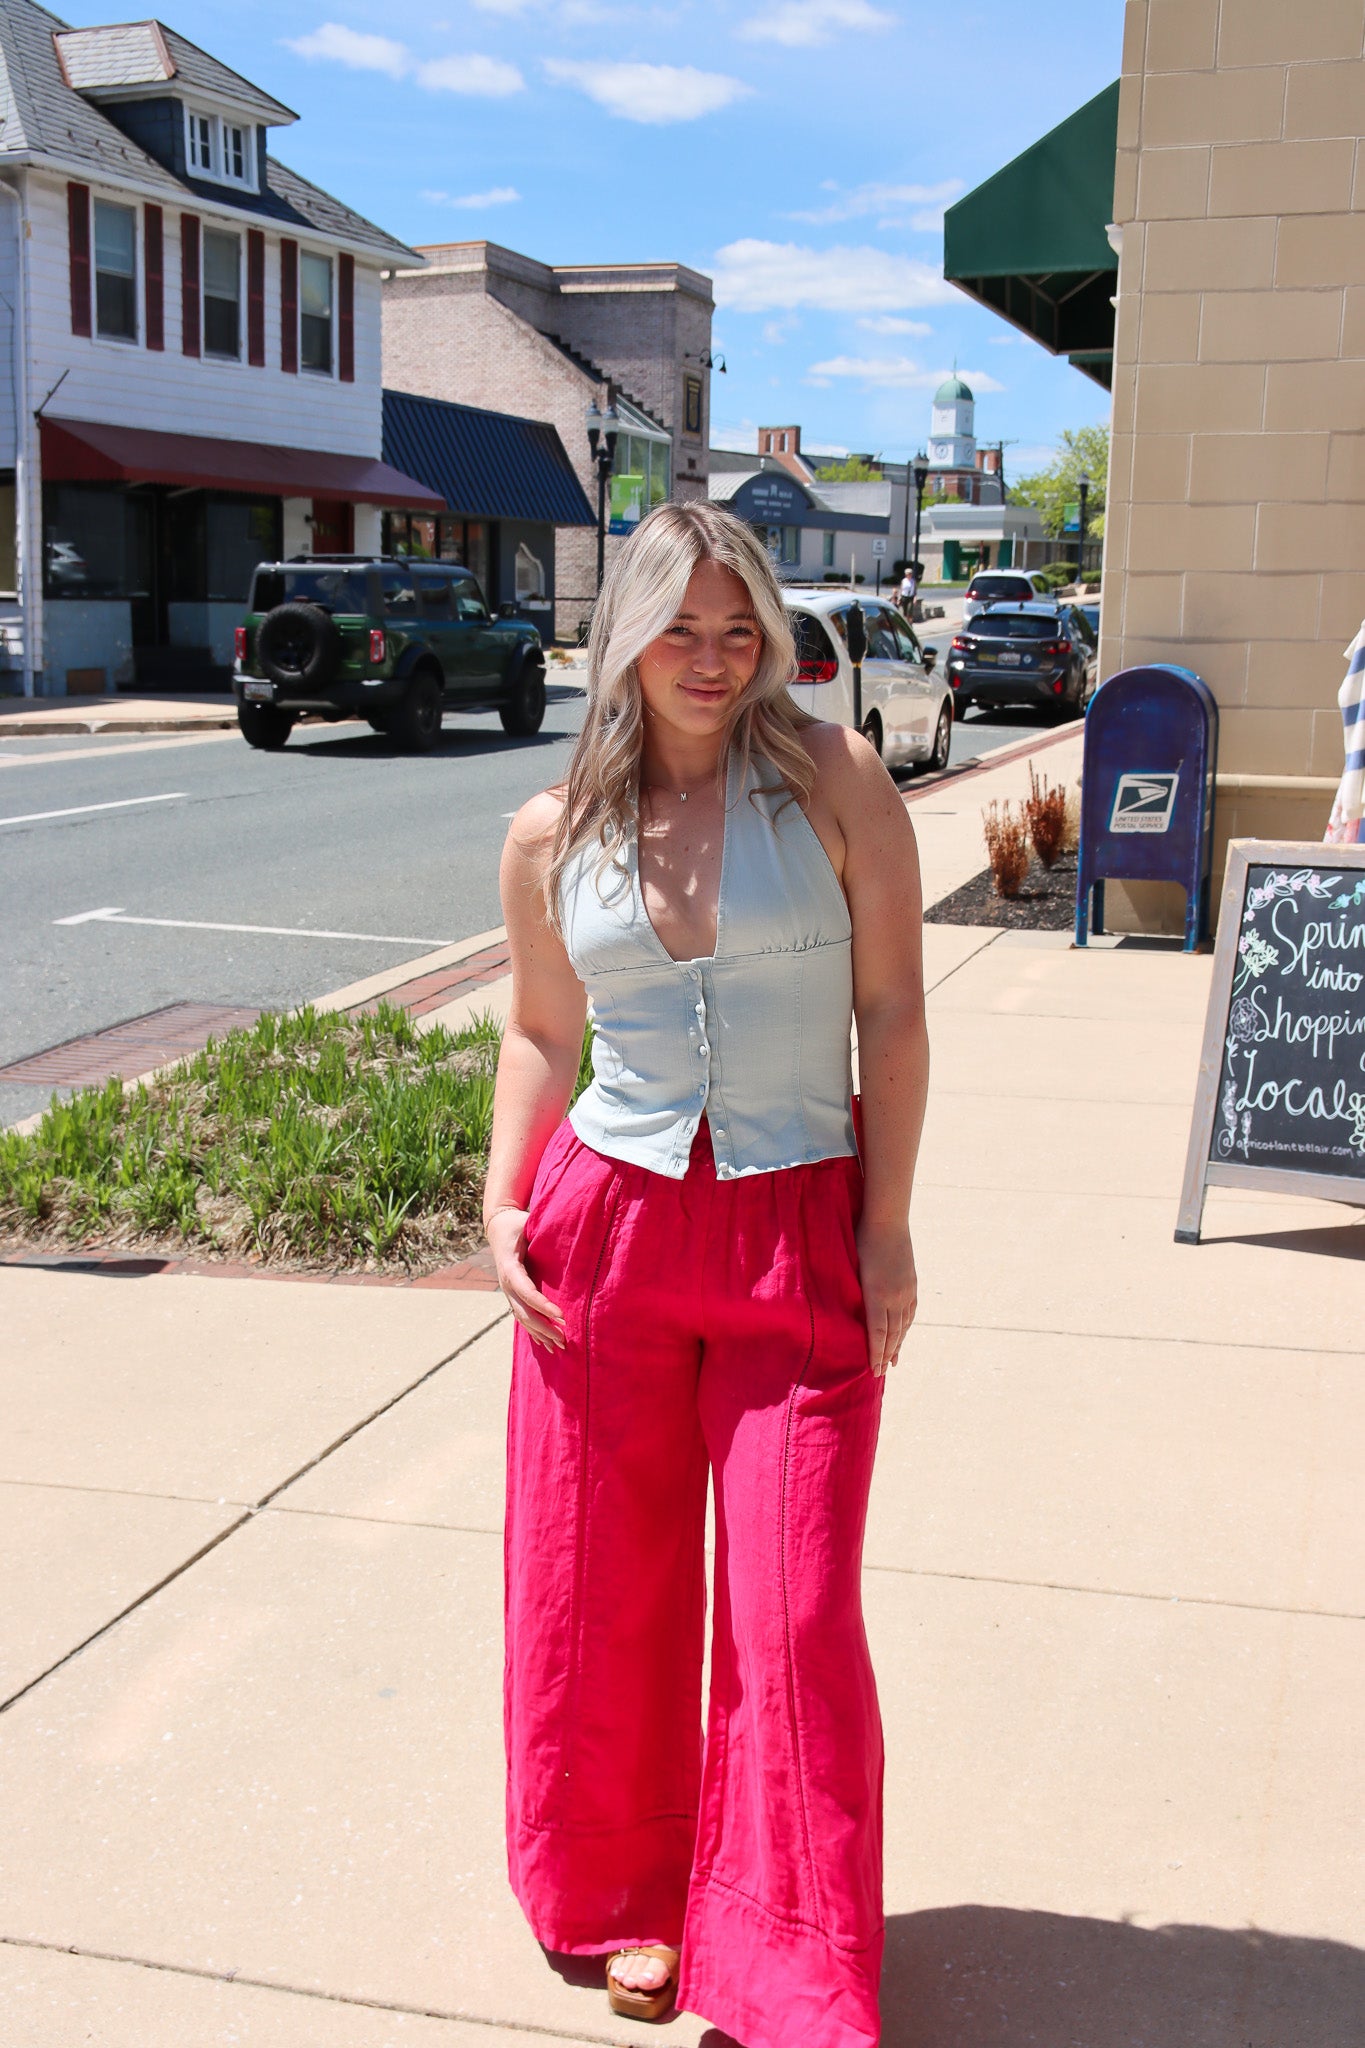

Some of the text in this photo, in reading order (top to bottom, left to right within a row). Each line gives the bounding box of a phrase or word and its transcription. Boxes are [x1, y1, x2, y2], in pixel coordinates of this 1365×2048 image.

[1271, 897, 1365, 977] Sprin
[1305, 960, 1364, 992] into
[1250, 984, 1365, 1060] Shoppin
